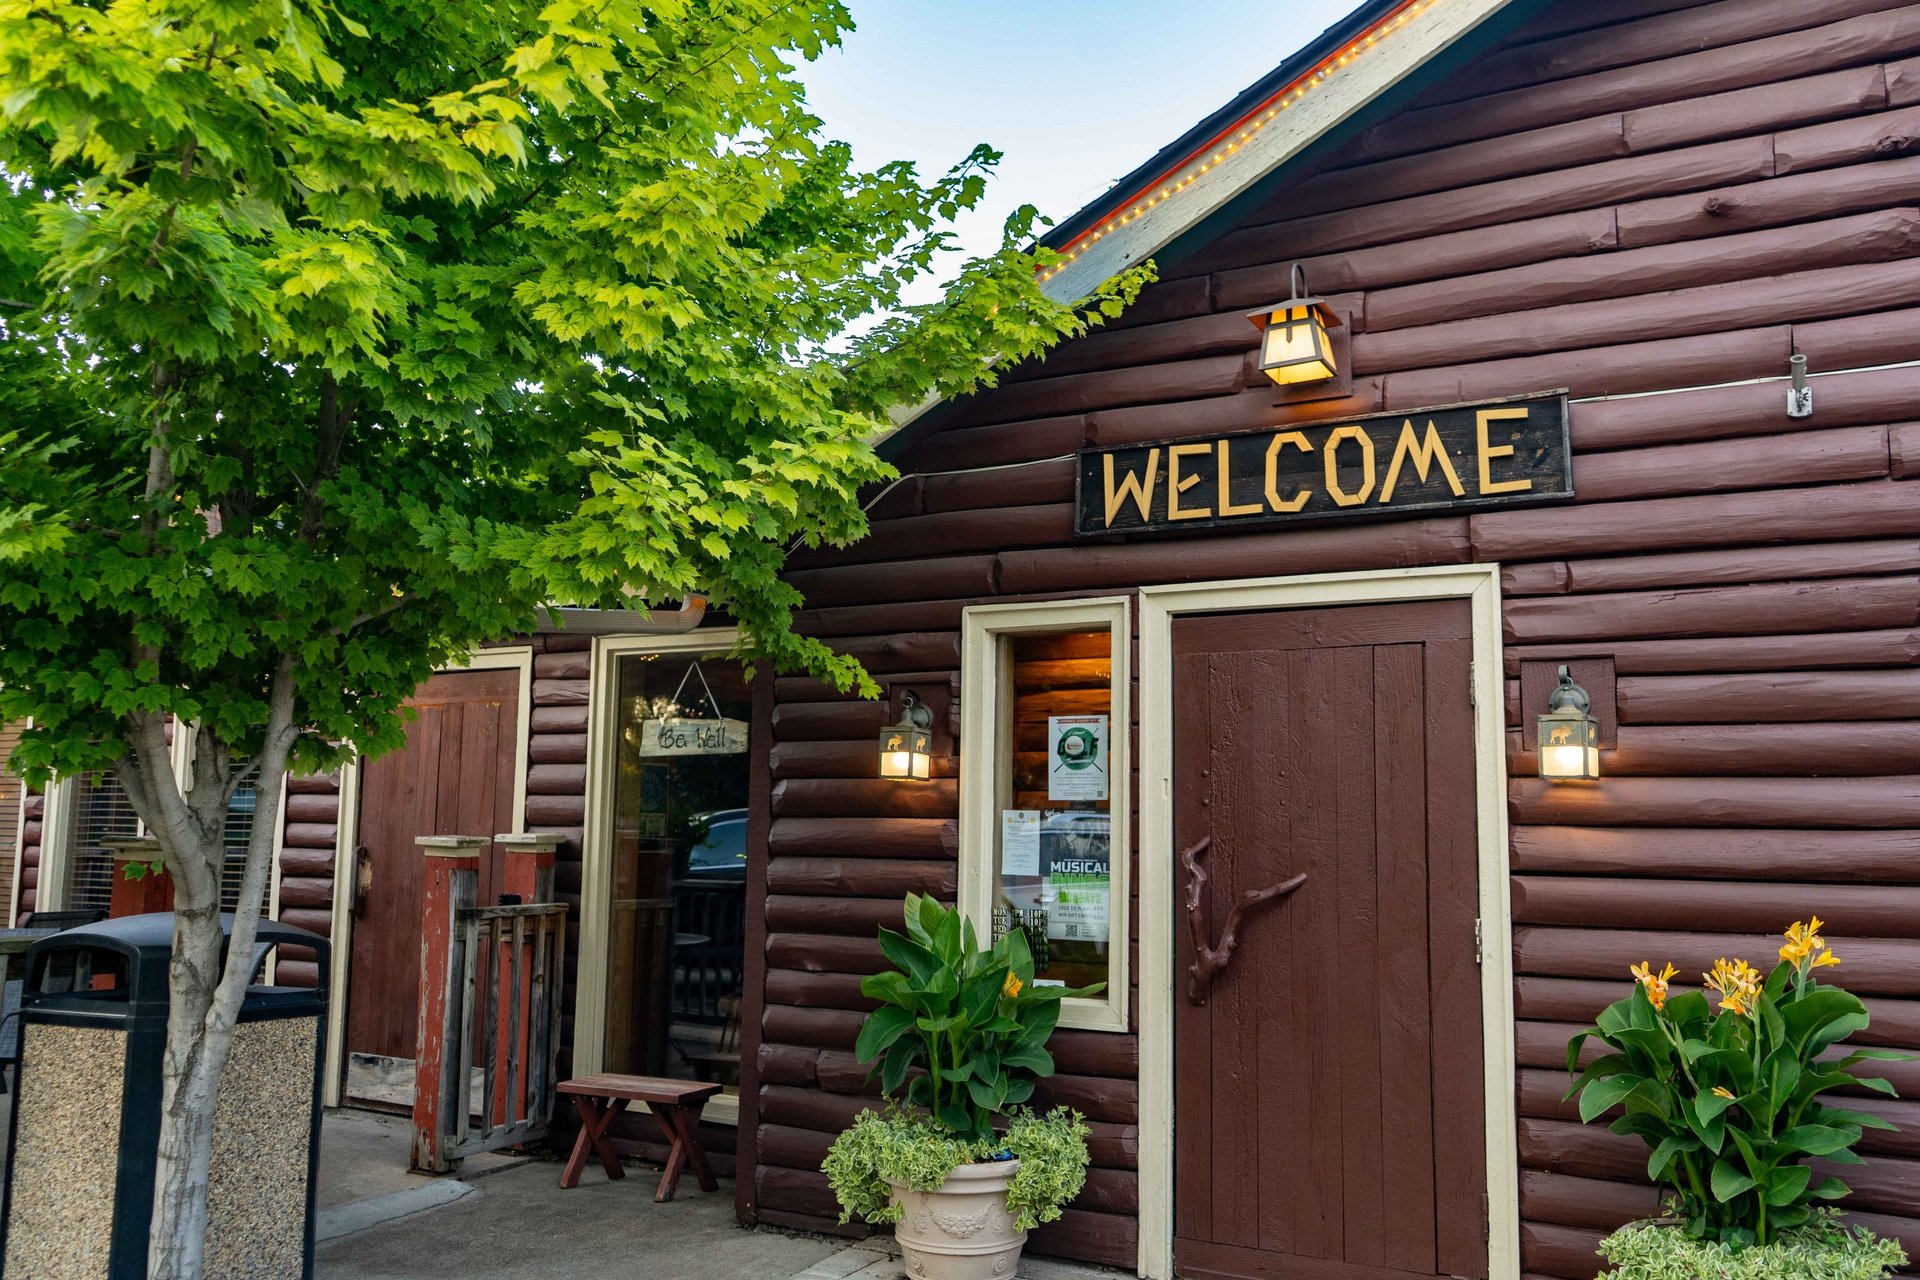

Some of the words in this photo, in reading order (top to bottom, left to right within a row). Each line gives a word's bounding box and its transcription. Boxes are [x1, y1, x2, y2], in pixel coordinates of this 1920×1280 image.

[1102, 408, 1533, 529] WELCOME
[660, 727, 688, 750] Be
[694, 726, 727, 749] Well
[1050, 861, 1110, 873] MUSICAL
[1050, 873, 1110, 889] BINGO
[993, 908, 1006, 916] MON
[993, 917, 1006, 925] TUE
[993, 925, 1007, 933] WED
